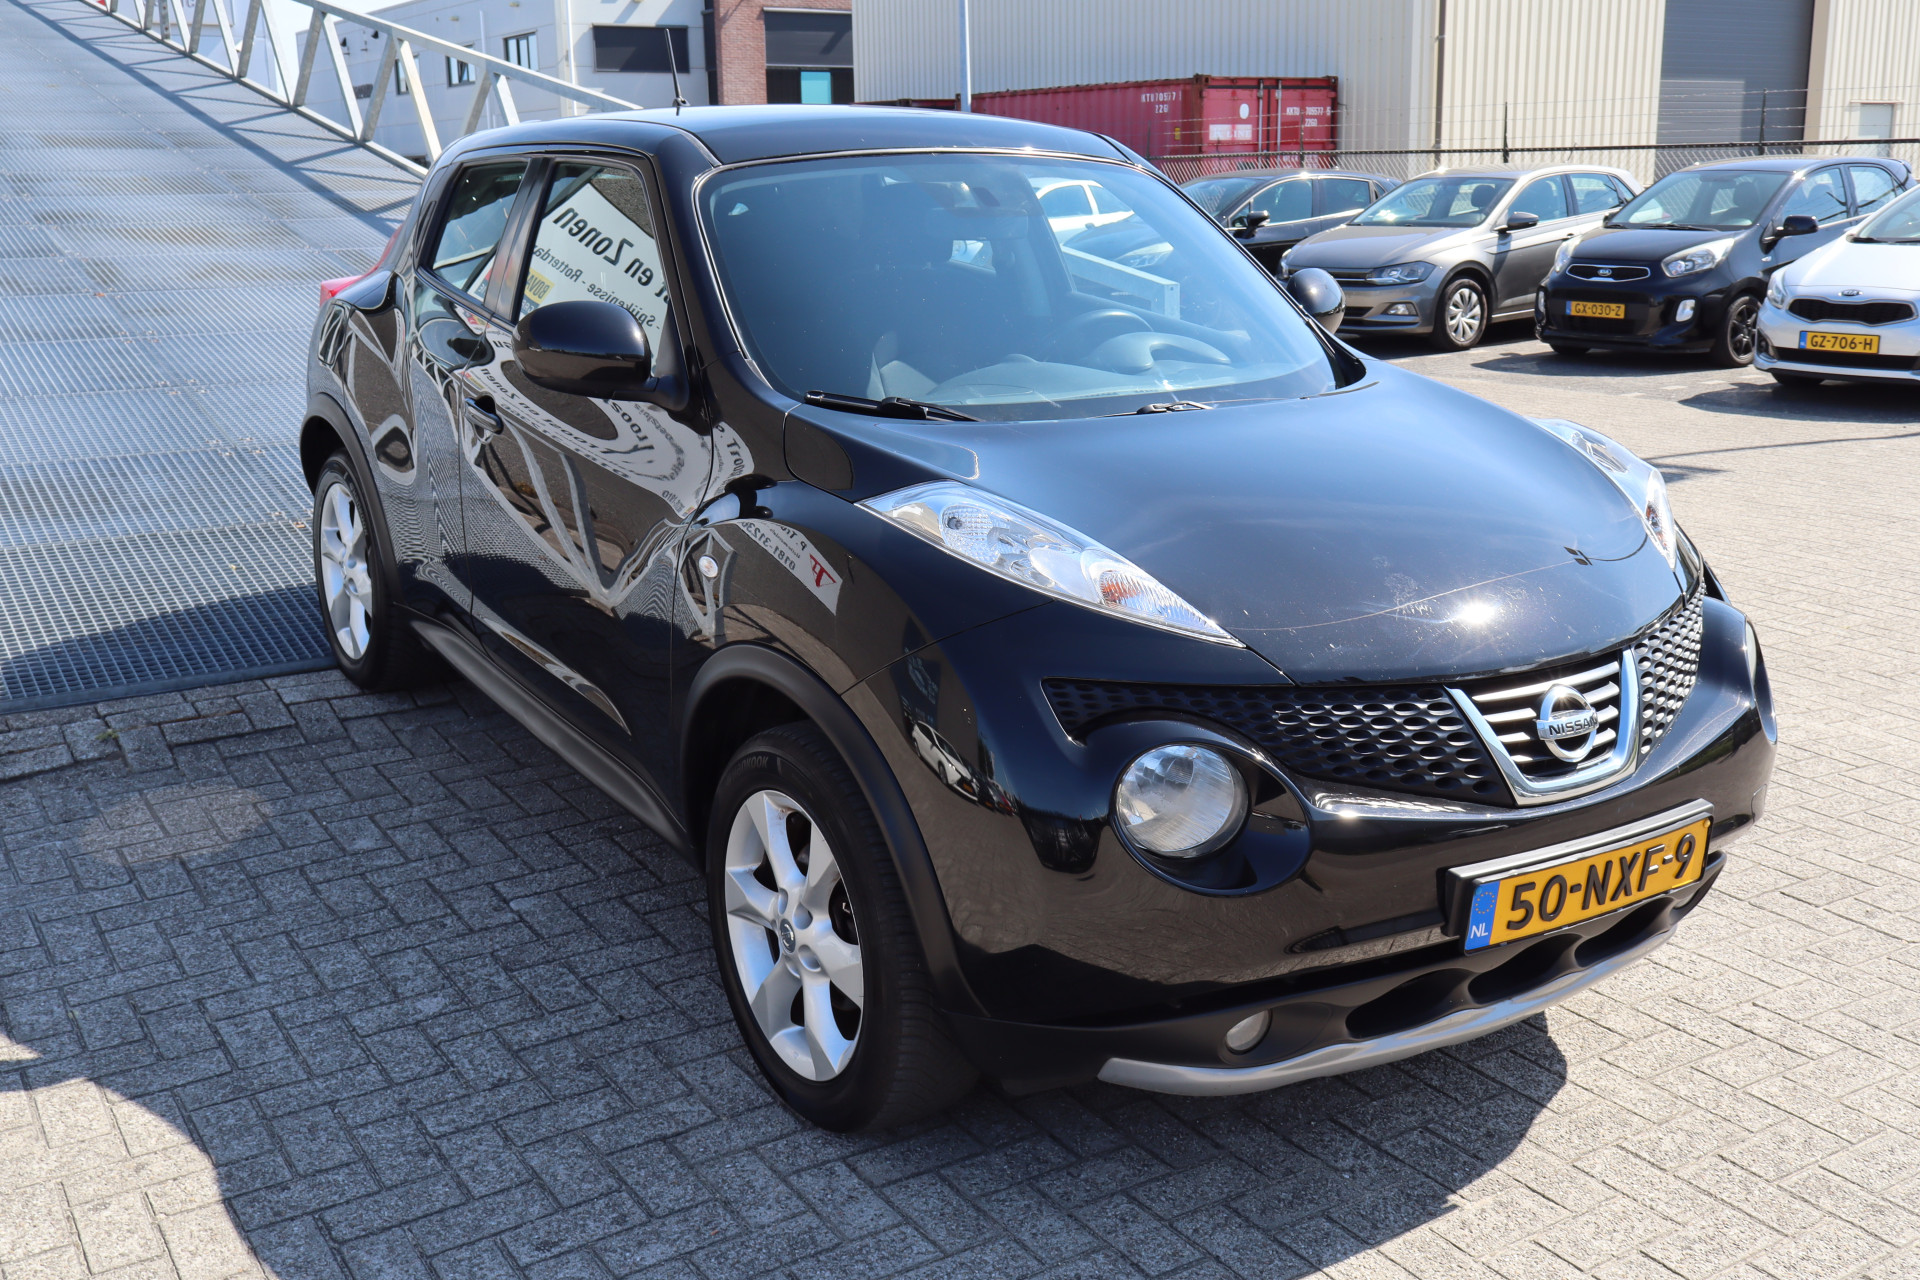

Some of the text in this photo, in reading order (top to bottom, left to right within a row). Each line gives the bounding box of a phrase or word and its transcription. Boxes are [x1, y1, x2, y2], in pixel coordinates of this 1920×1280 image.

[1574, 303, 1622, 317] GX-030-Z
[1809, 333, 1873, 351] GZ-706-H
[1548, 714, 1598, 736] NISSAN
[1470, 832, 1696, 939] NL 50-NXF-9
